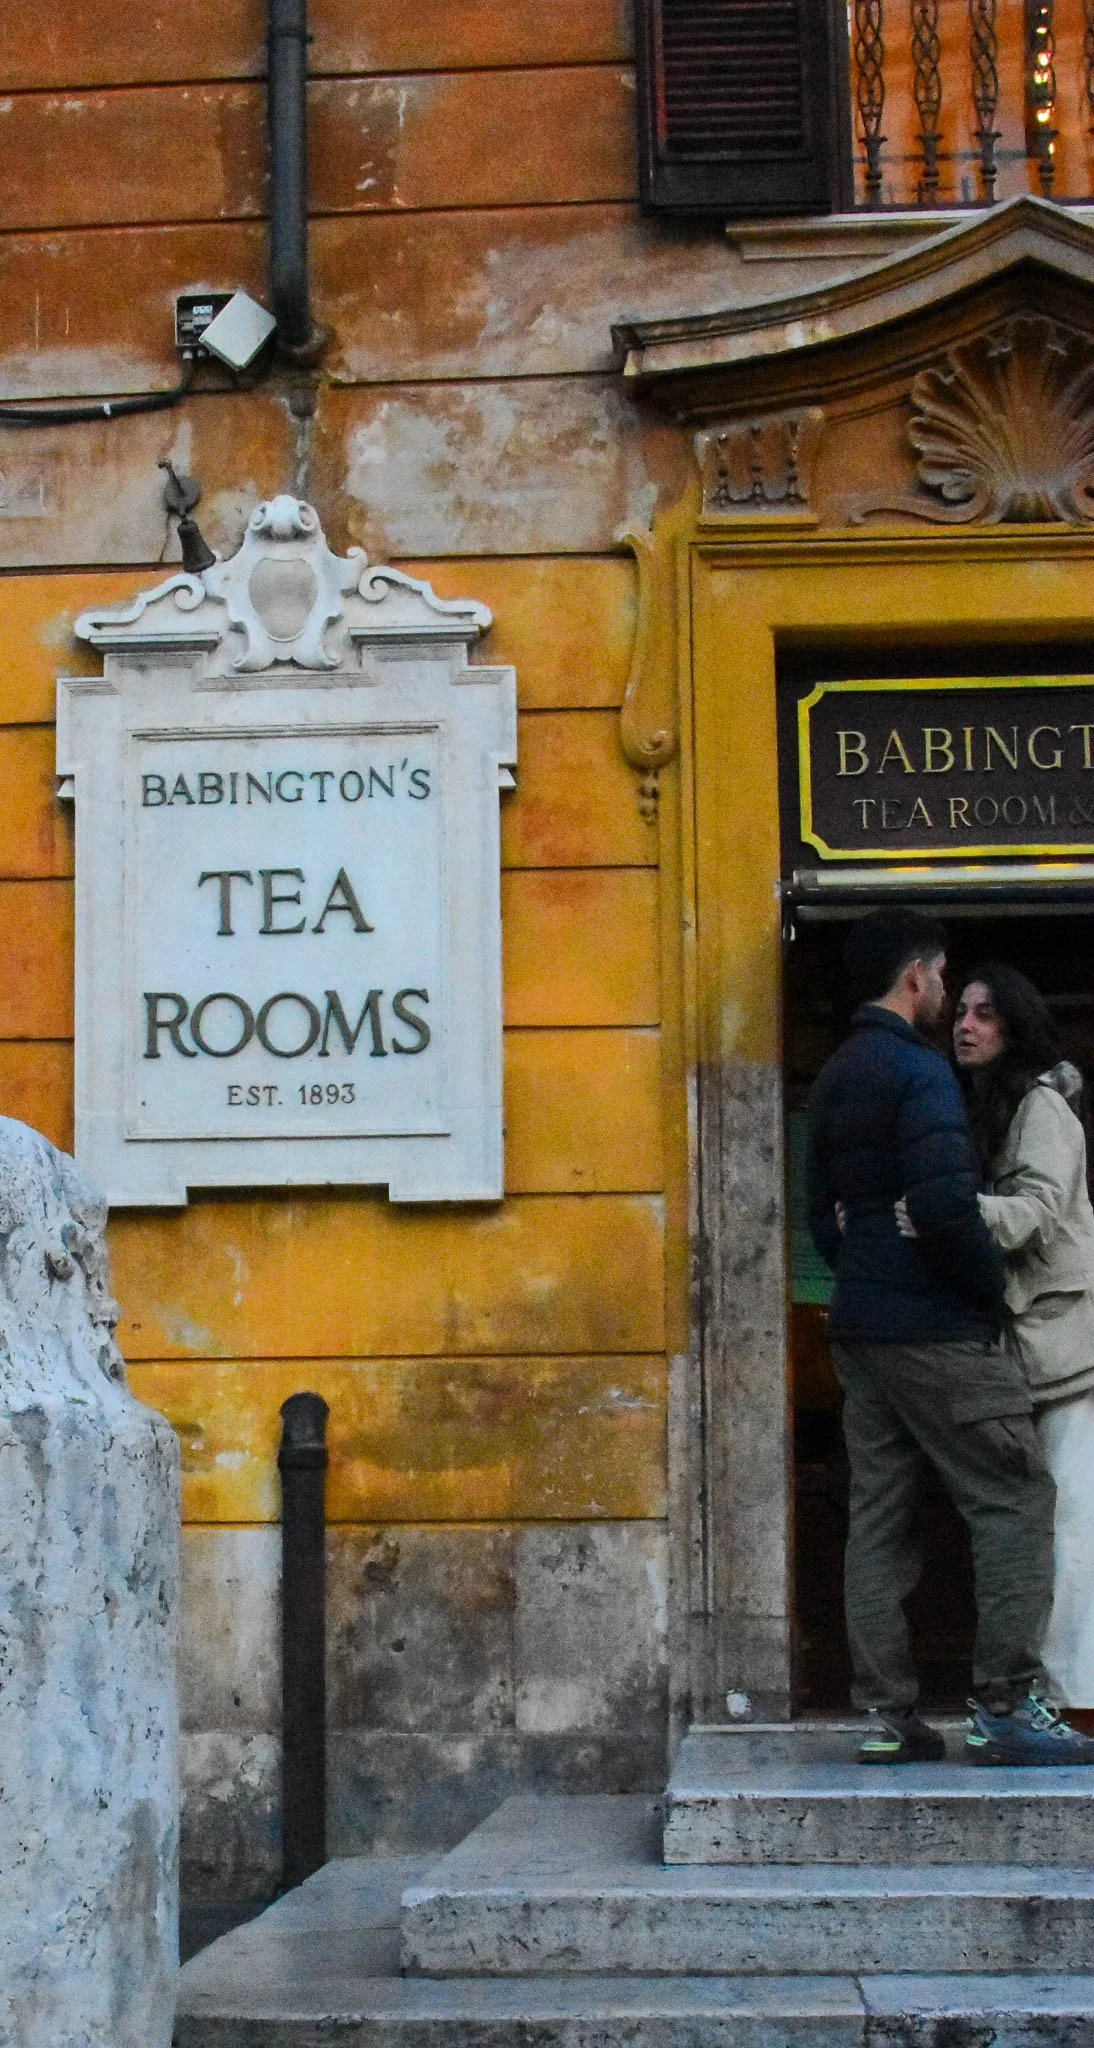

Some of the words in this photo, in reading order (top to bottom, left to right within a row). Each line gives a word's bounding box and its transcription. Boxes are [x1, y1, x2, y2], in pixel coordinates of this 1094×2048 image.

[141, 757, 431, 807] BABINGTON'S
[853, 796, 934, 830] TEA
[948, 795, 1057, 829] ROOM
[197, 866, 375, 936] TEA
[142, 987, 431, 1059] ROOMS
[226, 1084, 283, 1107] EST.
[298, 1082, 355, 1106] 1893
